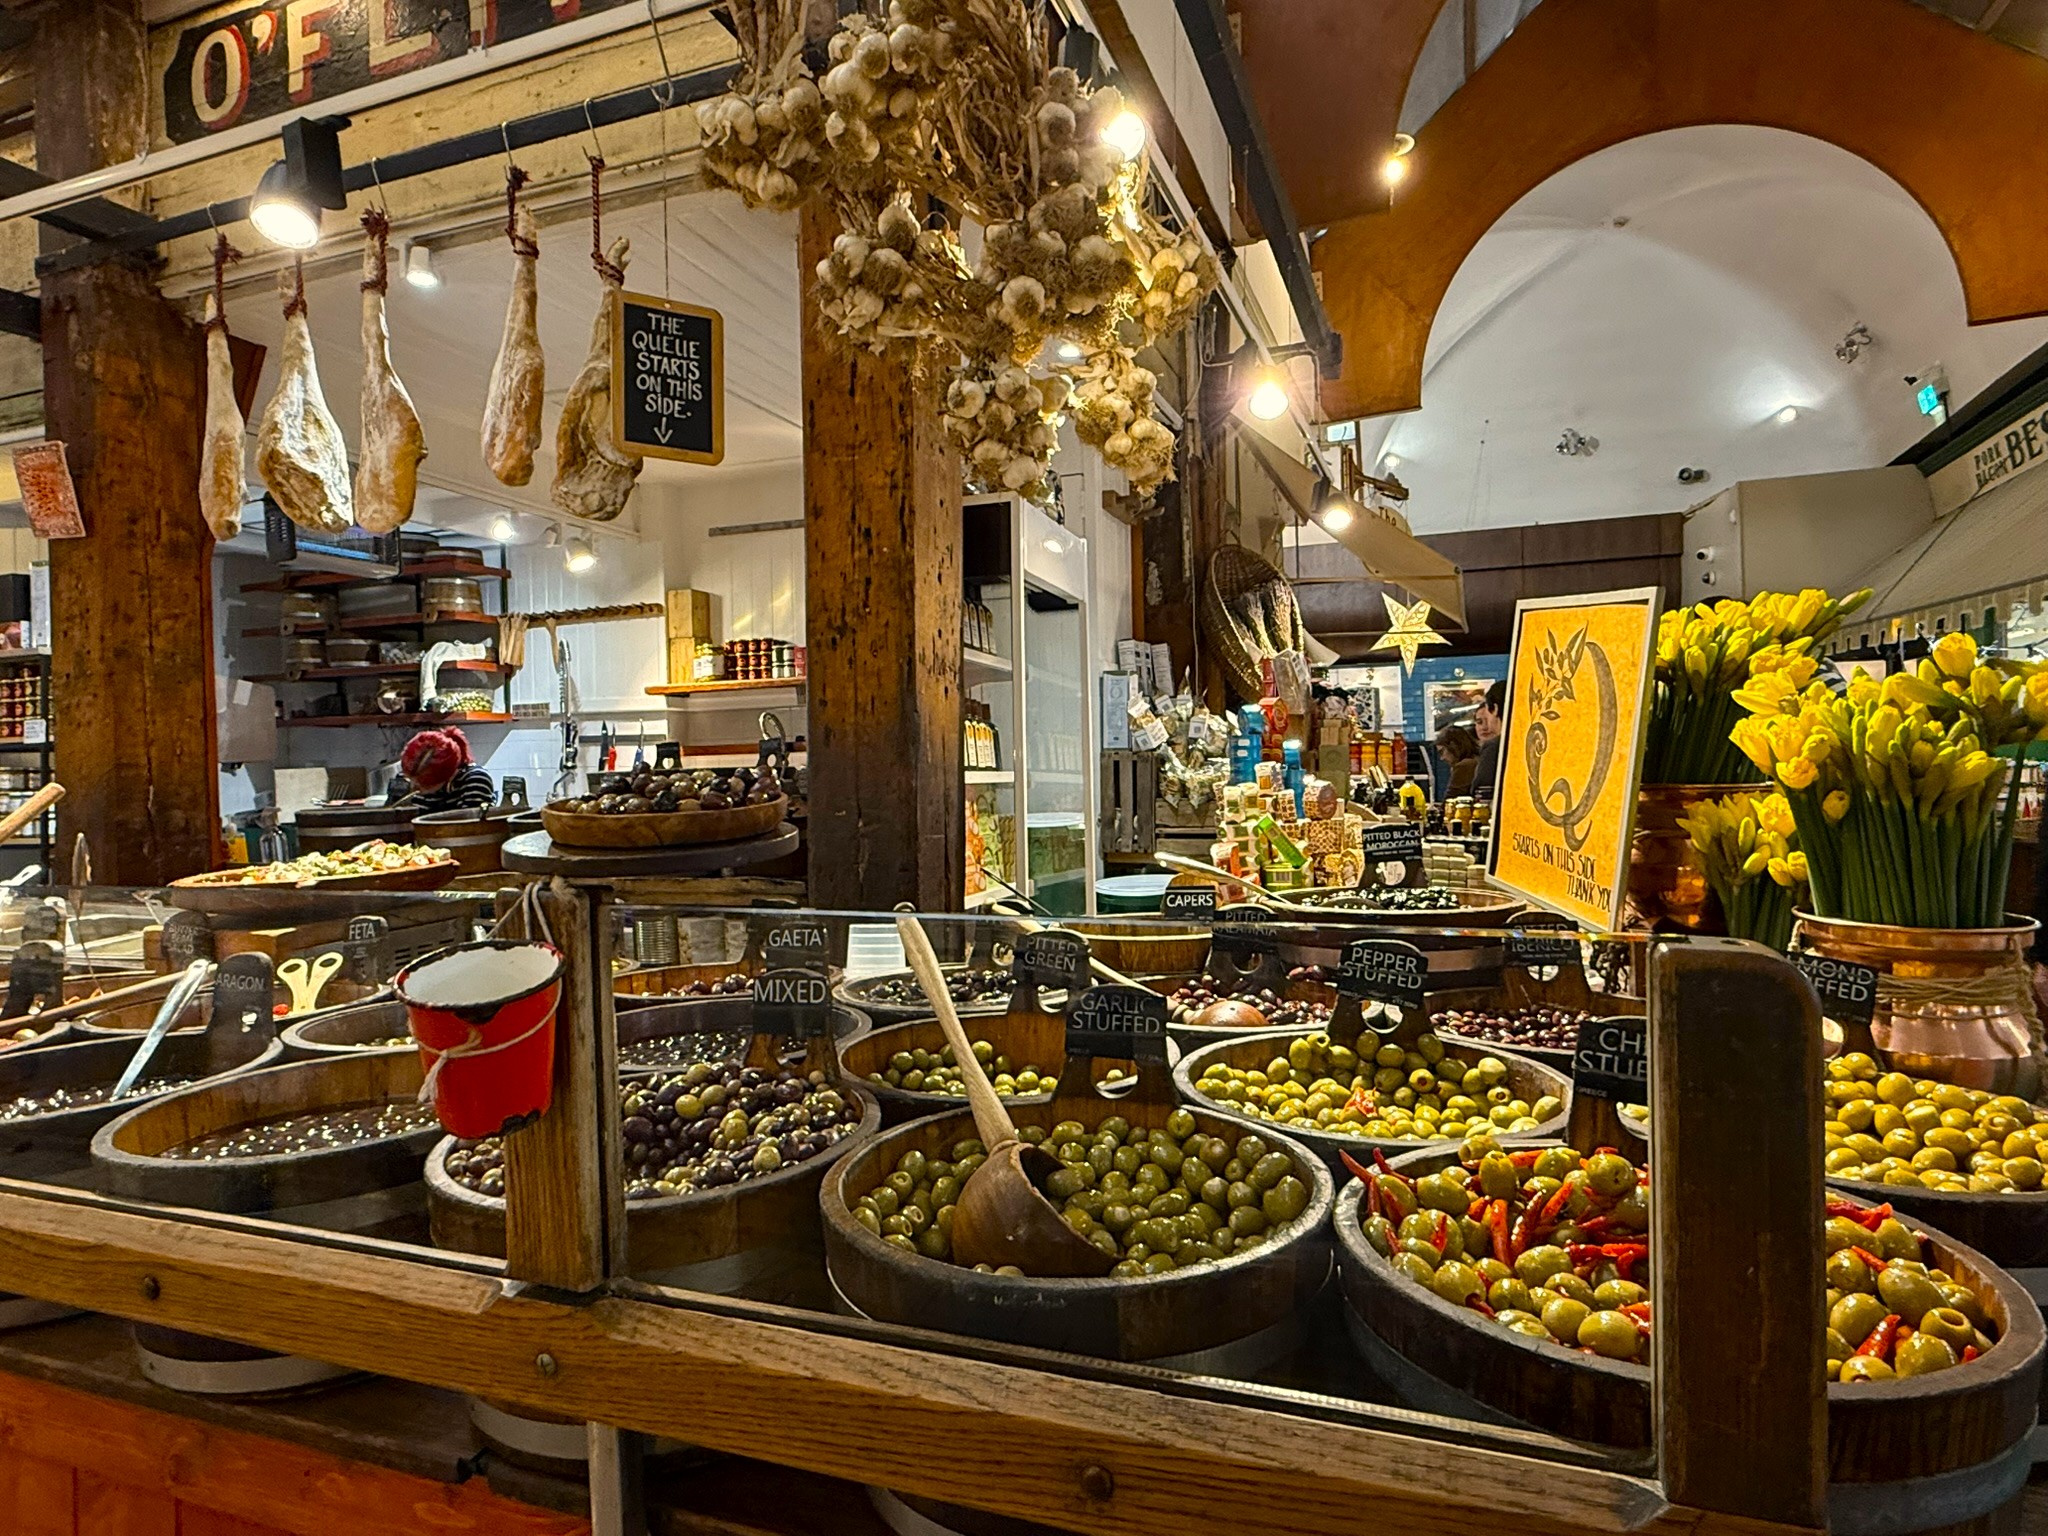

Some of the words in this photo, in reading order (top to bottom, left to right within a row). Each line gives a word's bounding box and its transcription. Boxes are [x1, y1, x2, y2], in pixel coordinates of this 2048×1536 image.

[647, 313, 685, 335] THE
[632, 330, 700, 359] QUEUE
[636, 352, 700, 380] STARTS
[636, 374, 661, 393] ON
[666, 378, 703, 401] THIS
[645, 394, 692, 418] SIDE.
[1363, 831, 1391, 841] PITTED
[1393, 829, 1420, 840] BLACK
[1512, 832, 1540, 859] STARTS
[1543, 843, 1554, 865] ON
[1556, 847, 1575, 873] THIS
[1166, 893, 1214, 907] CAPERS
[1567, 875, 1595, 905] THANK
[349, 922, 375, 940] FETA
[768, 929, 822, 947] GAETA
[1024, 951, 1077, 971] GREEN
[1351, 947, 1417, 973] PEPPER
[1788, 956, 1875, 985] MOND
[215, 973, 265, 992] ARAGON
[1342, 961, 1422, 989] STUFFED
[754, 979, 826, 1004] MIXED
[1812, 976, 1869, 1002] FFED
[1072, 1011, 1161, 1034] STUFFED
